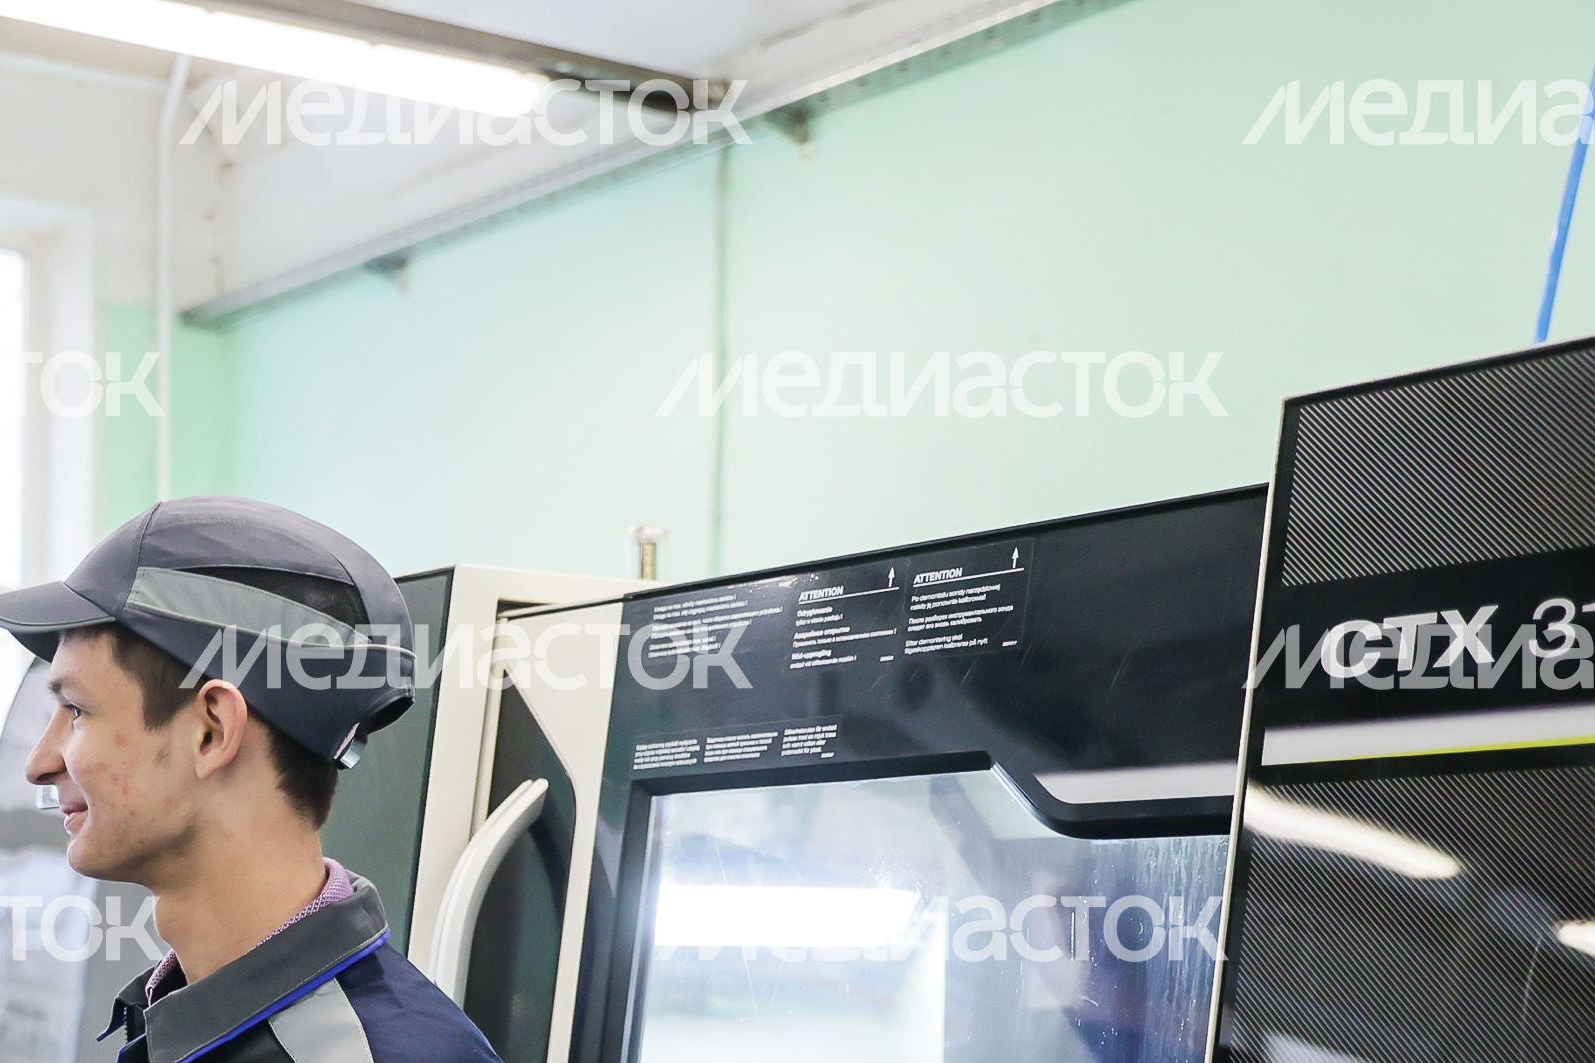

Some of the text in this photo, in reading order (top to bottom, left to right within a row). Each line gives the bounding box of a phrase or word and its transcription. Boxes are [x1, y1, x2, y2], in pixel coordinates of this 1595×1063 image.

[913, 568, 963, 584] ATTENTION
[799, 586, 844, 601] ATTENTION
[1321, 598, 1595, 678] CTX 3
